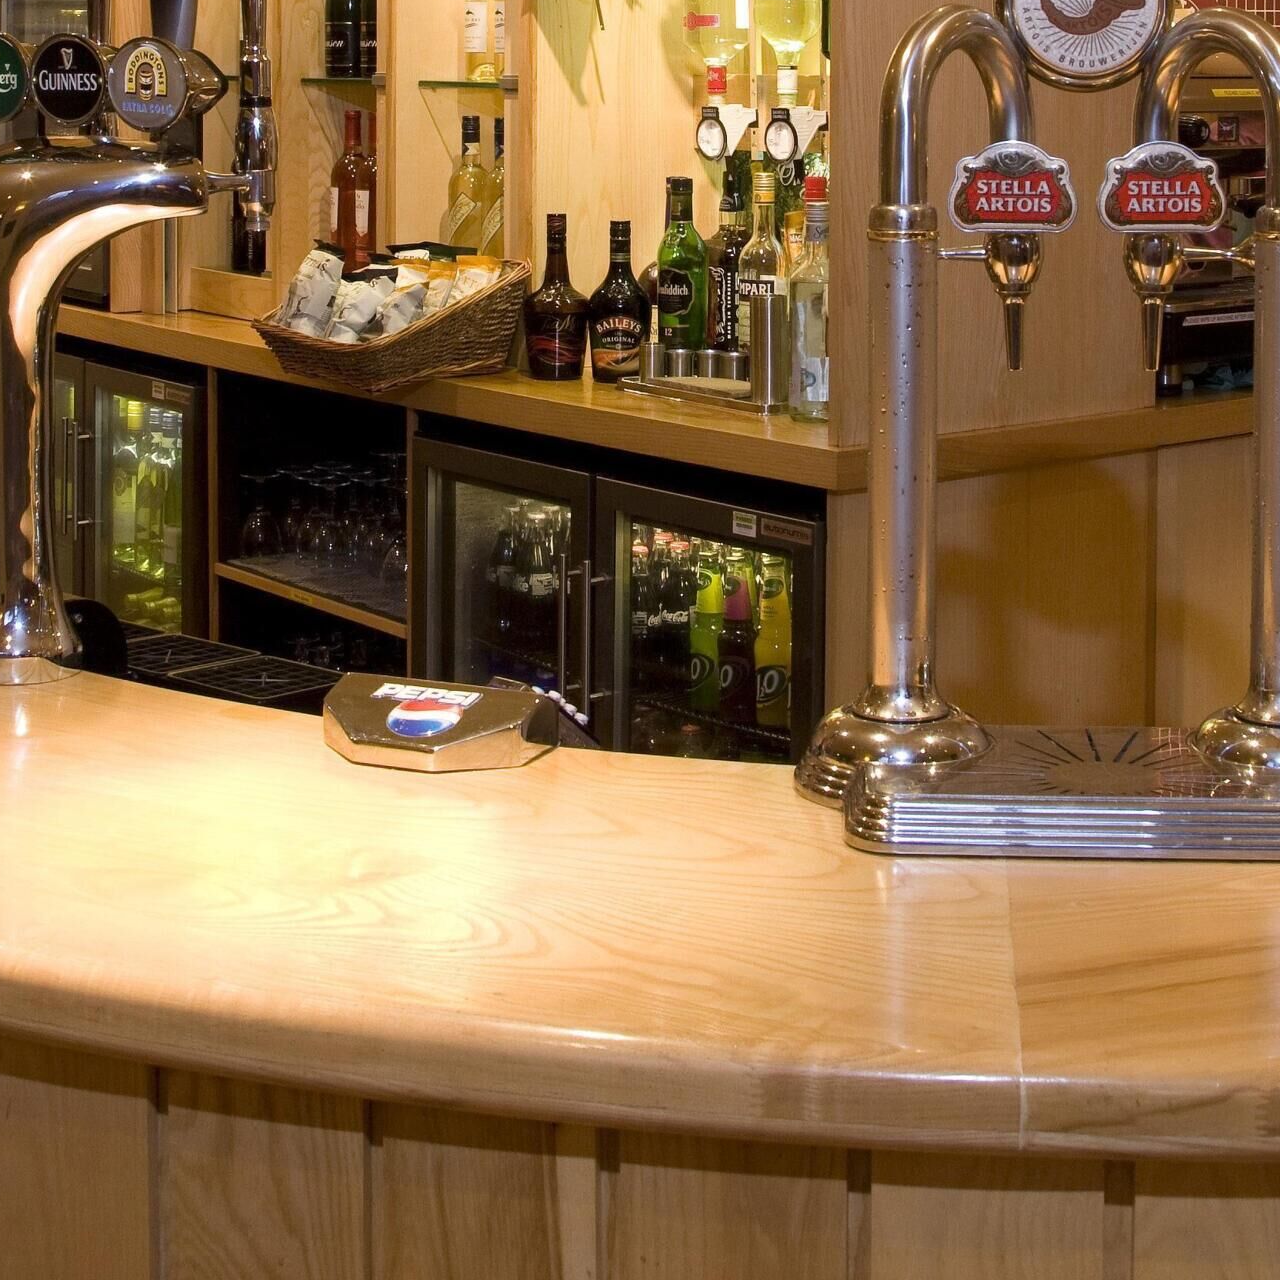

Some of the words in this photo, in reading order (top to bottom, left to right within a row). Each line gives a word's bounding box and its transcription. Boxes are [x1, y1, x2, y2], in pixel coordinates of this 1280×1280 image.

[1022, 6, 1052, 54] ARTOIS
[1058, 21, 1148, 68] BROUWERIJEN
[128, 51, 165, 85] BODDINGTONS
[39, 70, 98, 91] GUINNESS
[122, 102, 148, 113] EXTRA
[976, 179, 1051, 195] STELLA
[1127, 180, 1201, 195] STELLA
[976, 197, 1052, 213] ARTOIS
[1127, 197, 1202, 213] ARTOIS
[596, 319, 642, 334] BAILEYS
[664, 327, 673, 336] 12
[602, 336, 636, 345] ORIGINAL
[370, 682, 483, 710] PEPSI
